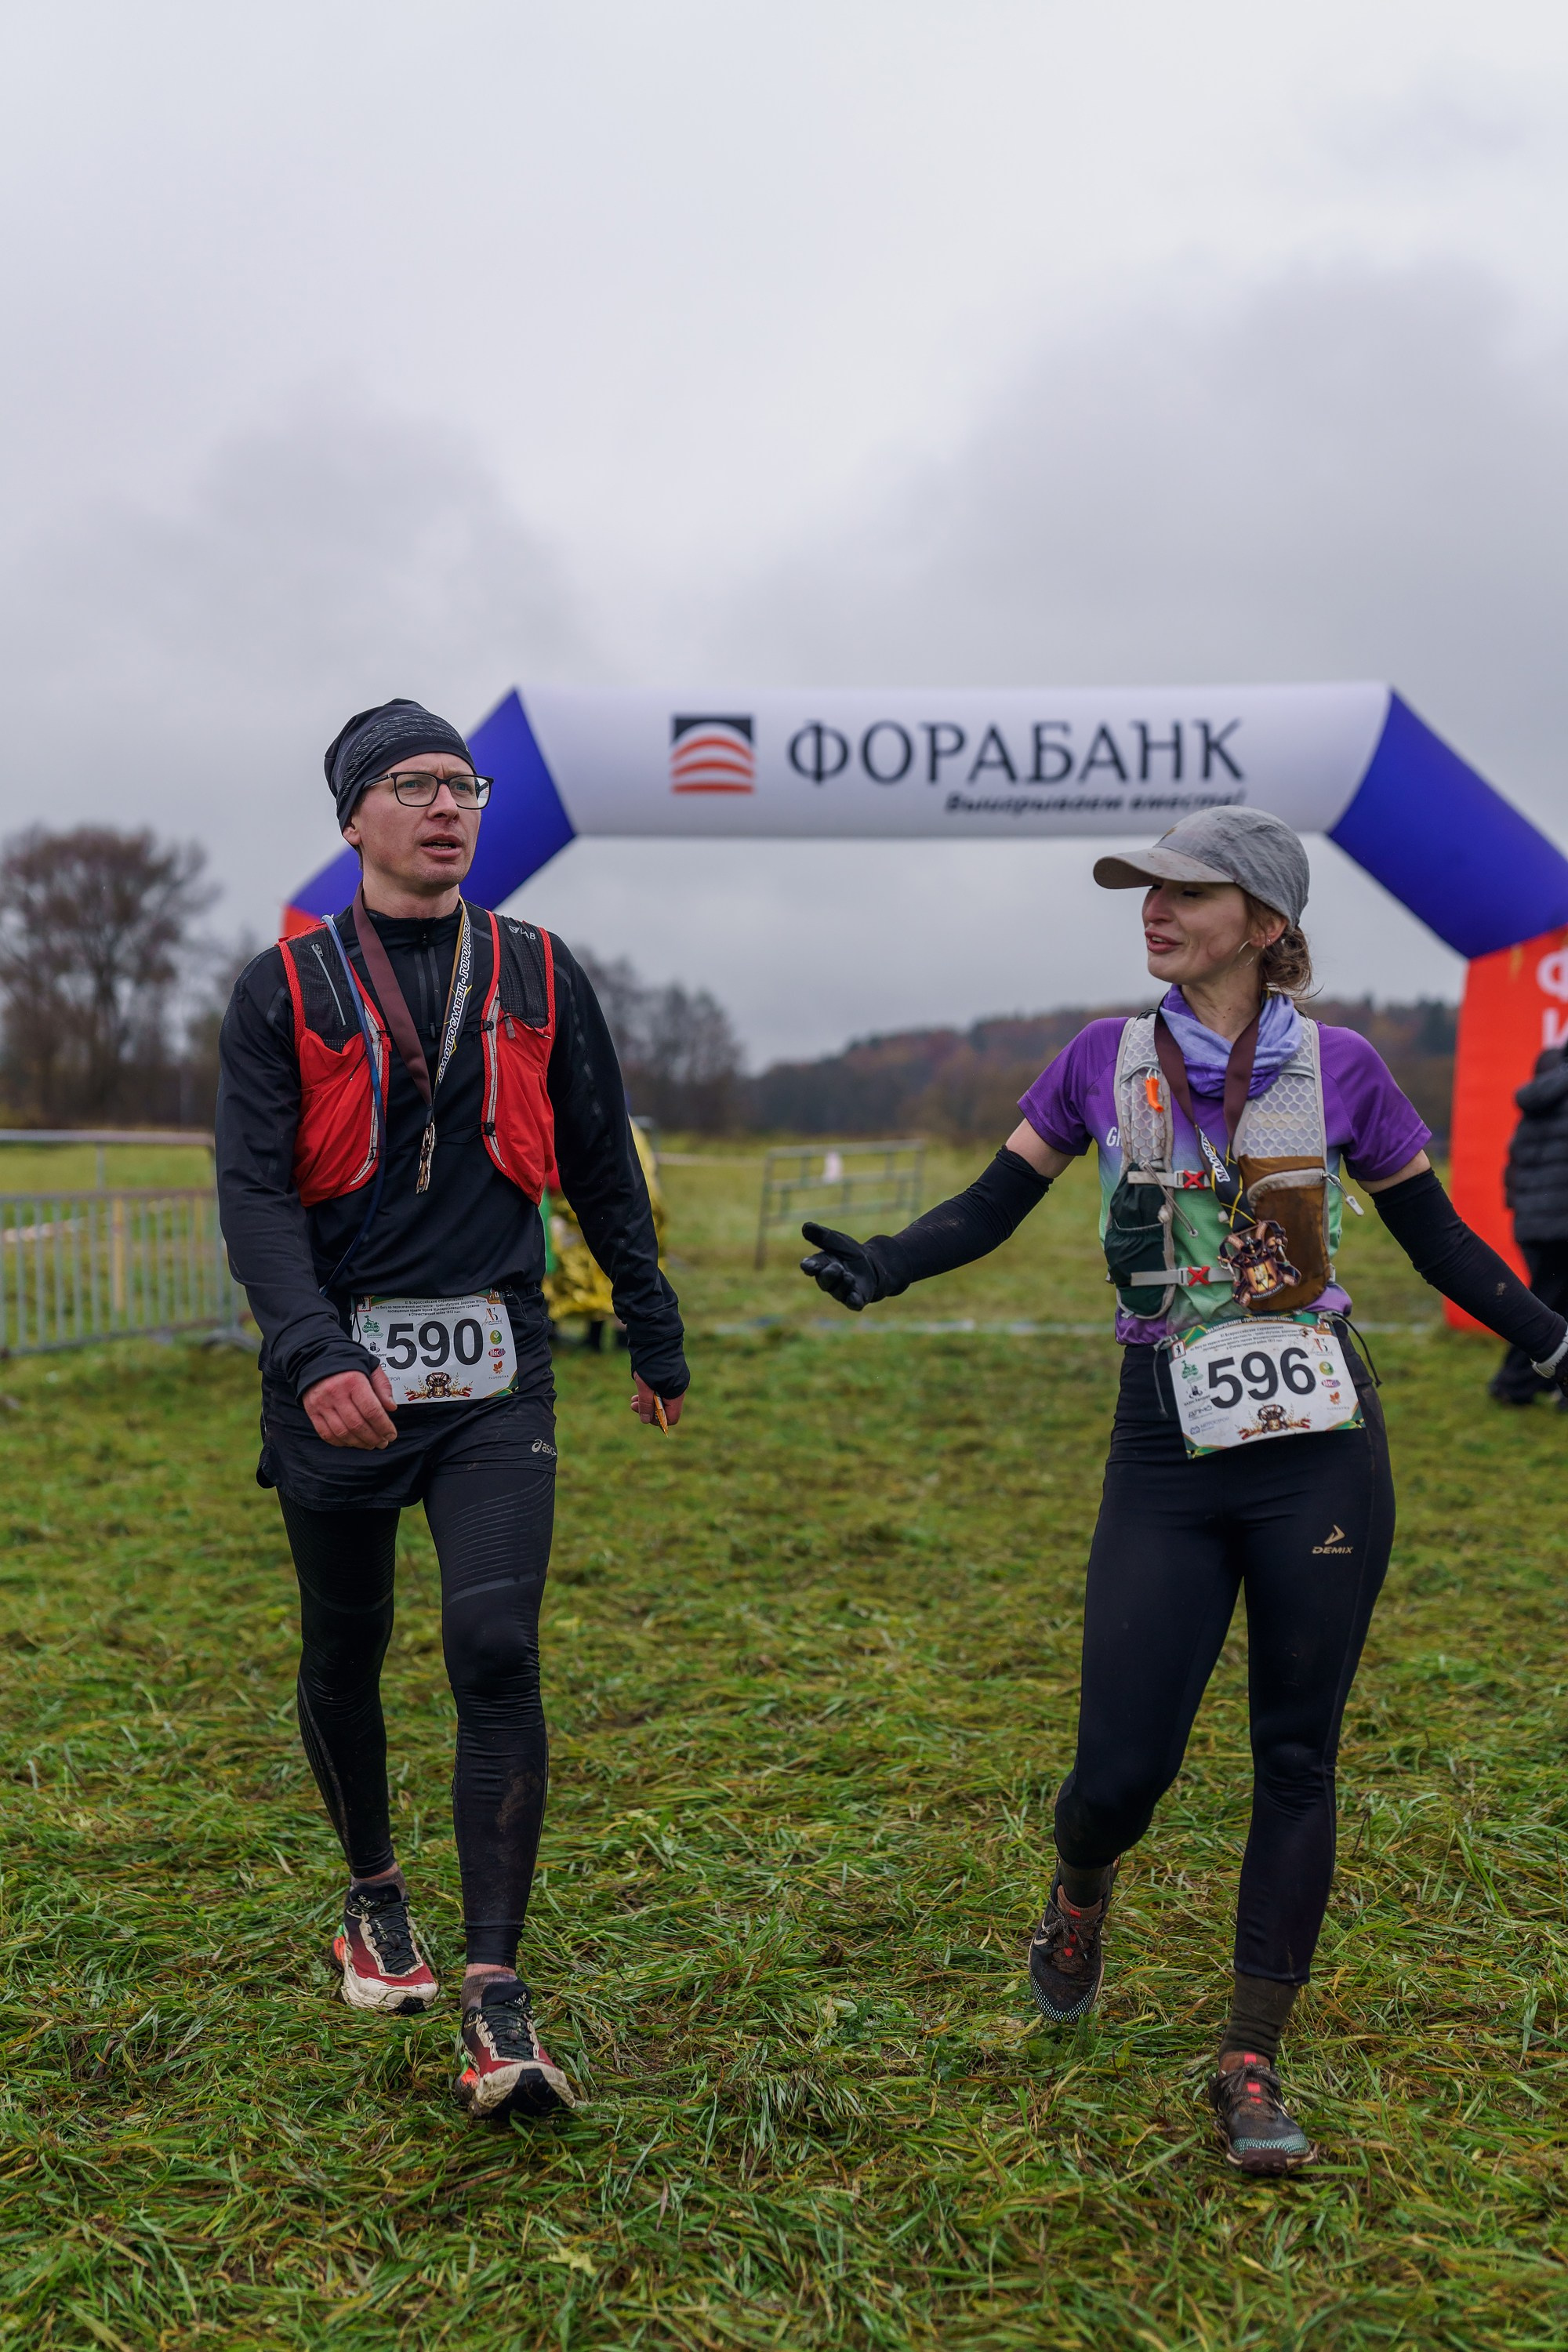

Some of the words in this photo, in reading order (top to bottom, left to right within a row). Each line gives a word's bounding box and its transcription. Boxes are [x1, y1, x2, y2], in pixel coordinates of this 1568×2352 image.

[788, 719, 1244, 785] ФОРАБАНК
[386, 1318, 484, 1370] 590
[1207, 1347, 1316, 1410] 596
